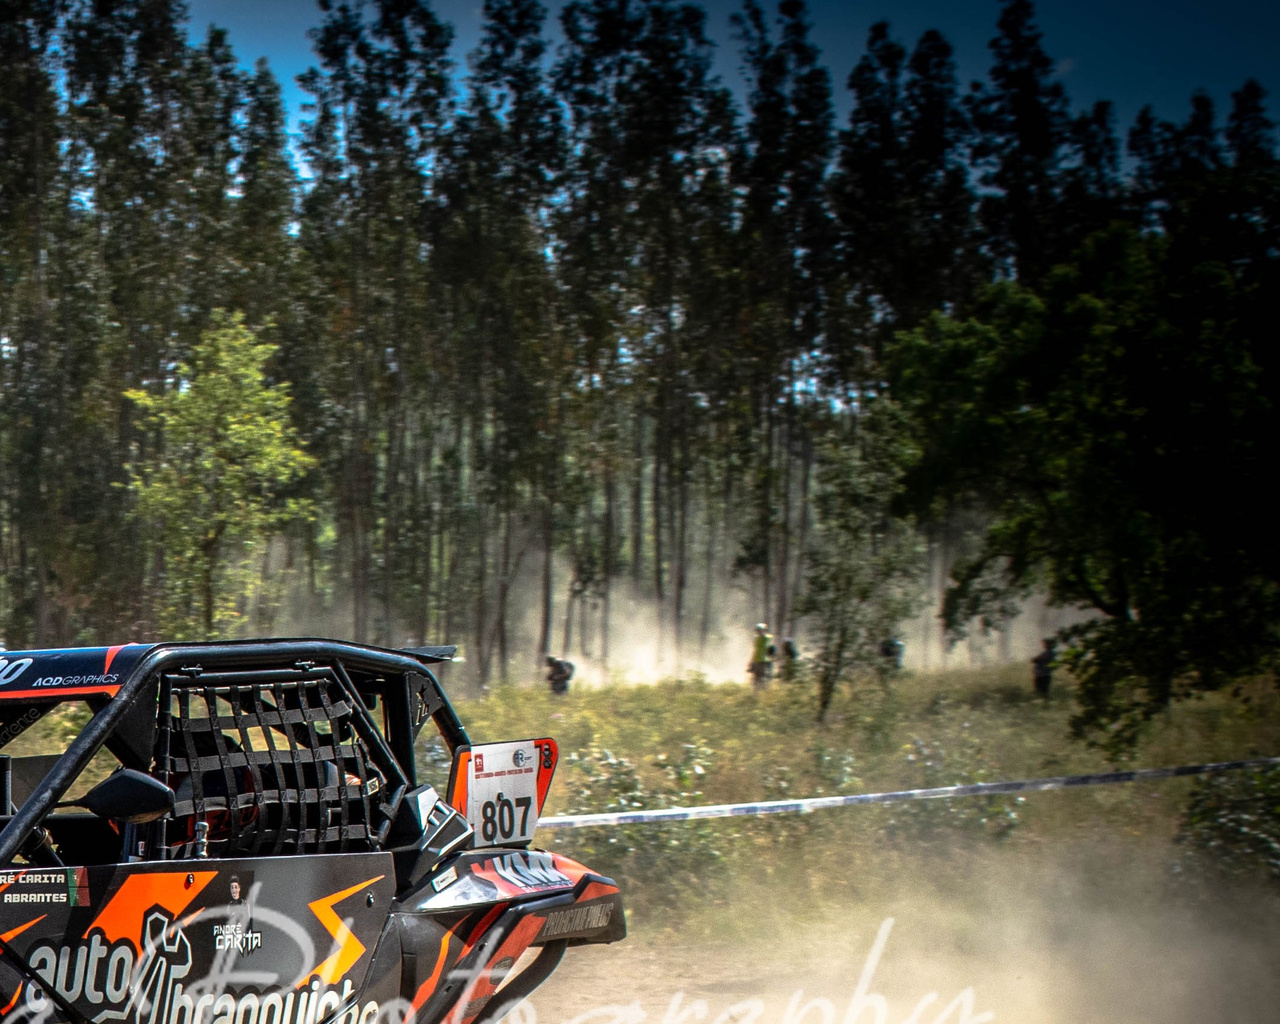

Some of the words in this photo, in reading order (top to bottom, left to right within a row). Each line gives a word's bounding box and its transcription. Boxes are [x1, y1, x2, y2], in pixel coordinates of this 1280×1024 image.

[481, 796, 532, 842] 807
[18, 874, 65, 884] CARITA
[4, 893, 67, 903] ABRANTES
[25, 936, 133, 1013] auto
